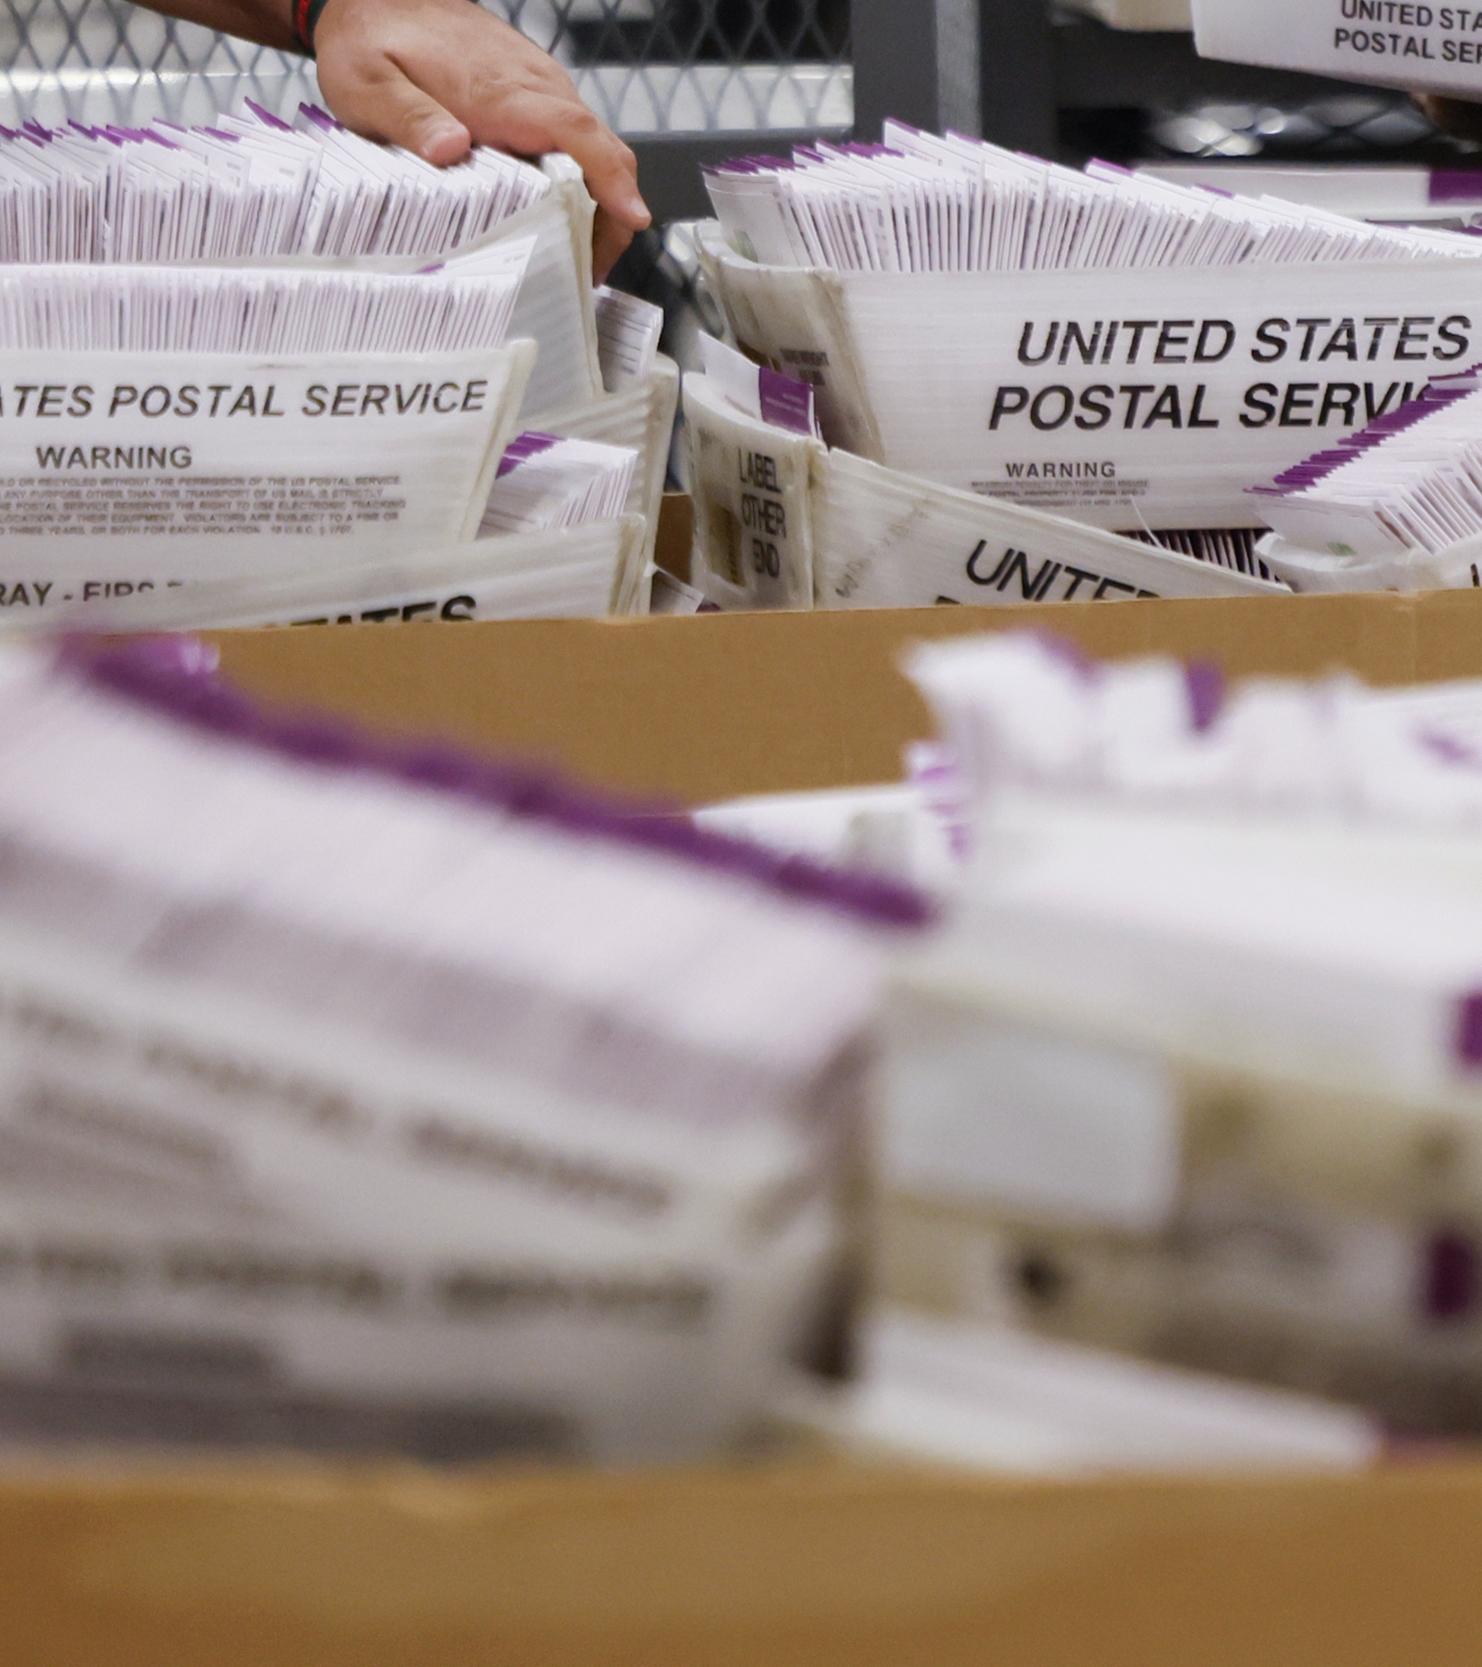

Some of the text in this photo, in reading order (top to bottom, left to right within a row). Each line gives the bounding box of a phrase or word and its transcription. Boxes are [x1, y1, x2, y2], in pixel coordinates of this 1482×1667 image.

[1333, 28, 1435, 63] POSTAL
[1018, 314, 1472, 367] UNITED STATES
[108, 384, 285, 418] POSTAL
[301, 379, 489, 417] SERVICE
[988, 382, 1220, 432] POSTAL
[35, 446, 193, 470] WARNING
[738, 448, 782, 495] LABEL
[1005, 461, 1116, 478] WARNING
[741, 492, 787, 540] OTHER
[752, 537, 781, 579] END
